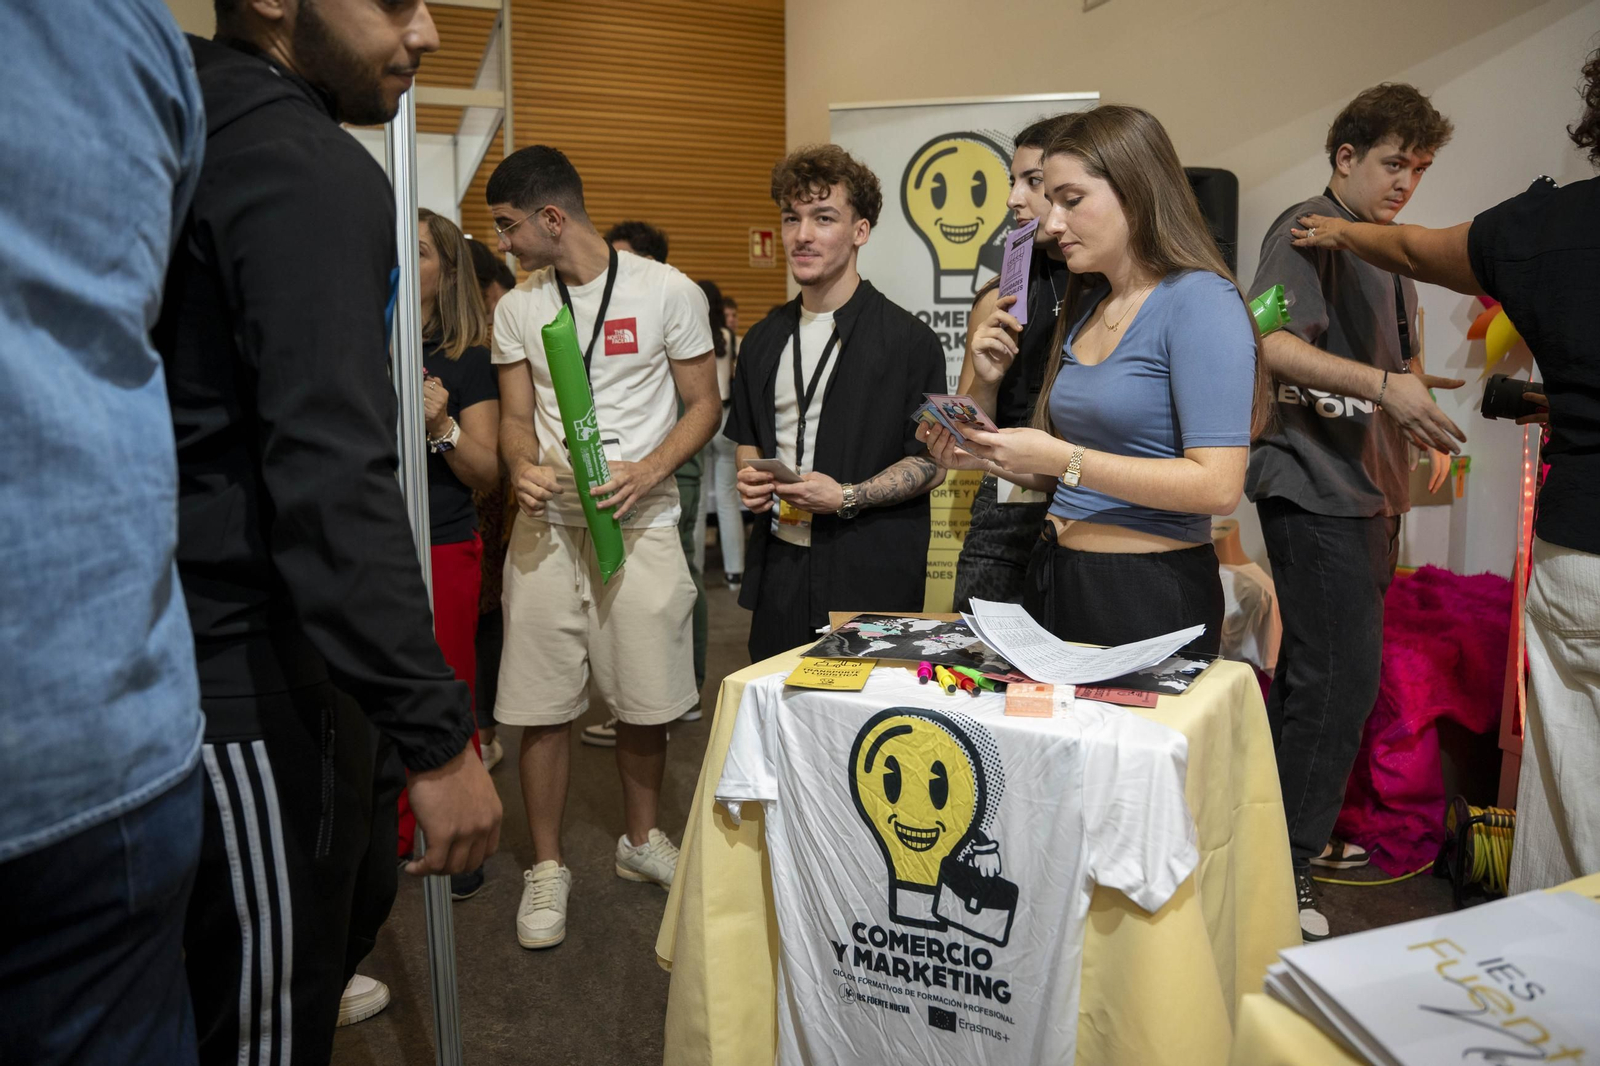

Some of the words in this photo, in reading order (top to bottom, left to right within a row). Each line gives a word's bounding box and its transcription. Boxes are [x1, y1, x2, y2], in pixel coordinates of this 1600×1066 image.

[852, 921, 993, 971] COMERCIO
[831, 940, 849, 963] Y
[854, 945, 1012, 1005] MARKETING
[1477, 956, 1546, 1002] IES
[858, 976, 903, 995] FORMATIVOS
[905, 988, 916, 997] DE
[917, 991, 962, 1009] FORMACIÓN
[963, 1002, 1016, 1025] PROFESIONAL
[867, 995, 888, 1009] FUENTE
[889, 1001, 911, 1015] NUEVA
[958, 1017, 1011, 1043] Erasmus+
